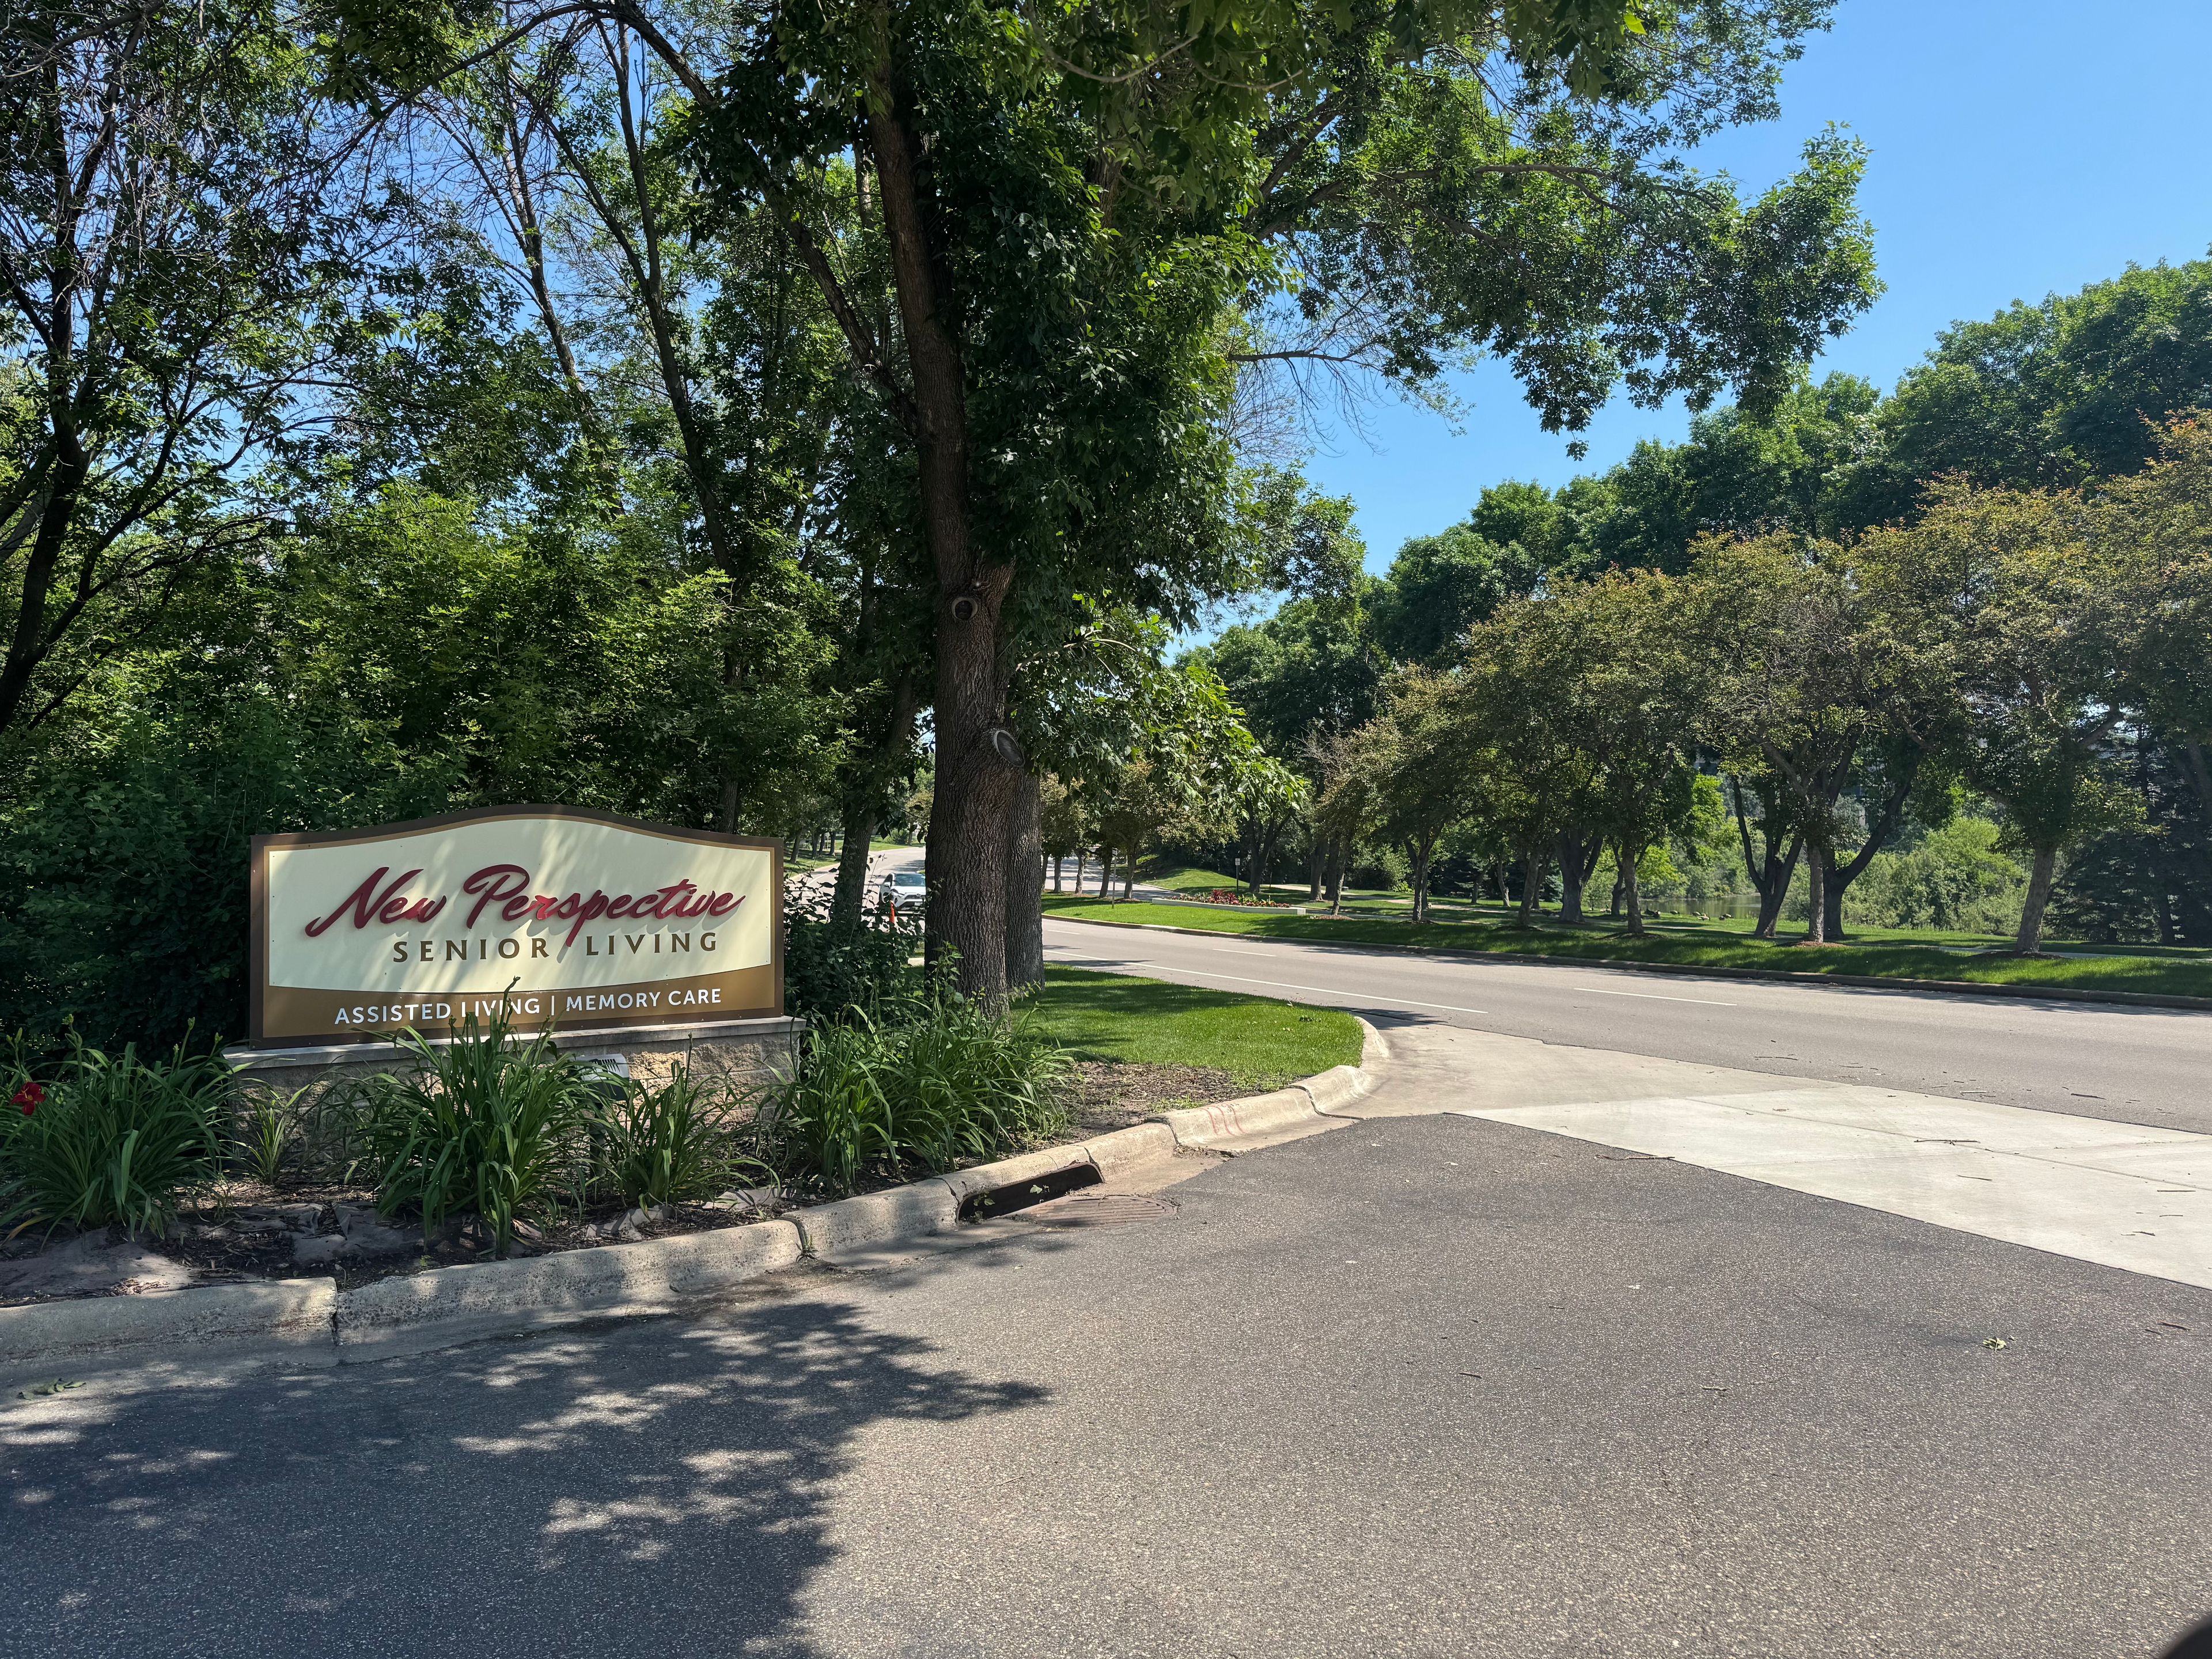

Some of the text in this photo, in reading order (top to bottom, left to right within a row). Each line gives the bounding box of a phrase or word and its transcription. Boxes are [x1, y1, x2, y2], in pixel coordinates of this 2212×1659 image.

[305, 864, 746, 946] New Perspective
[393, 933, 717, 962] SENIOR LIVING
[335, 1003, 450, 1024] ASSISTED
[461, 998, 540, 1017] LIVING
[566, 991, 661, 1012] MEMORY
[668, 988, 721, 1006] CARE
